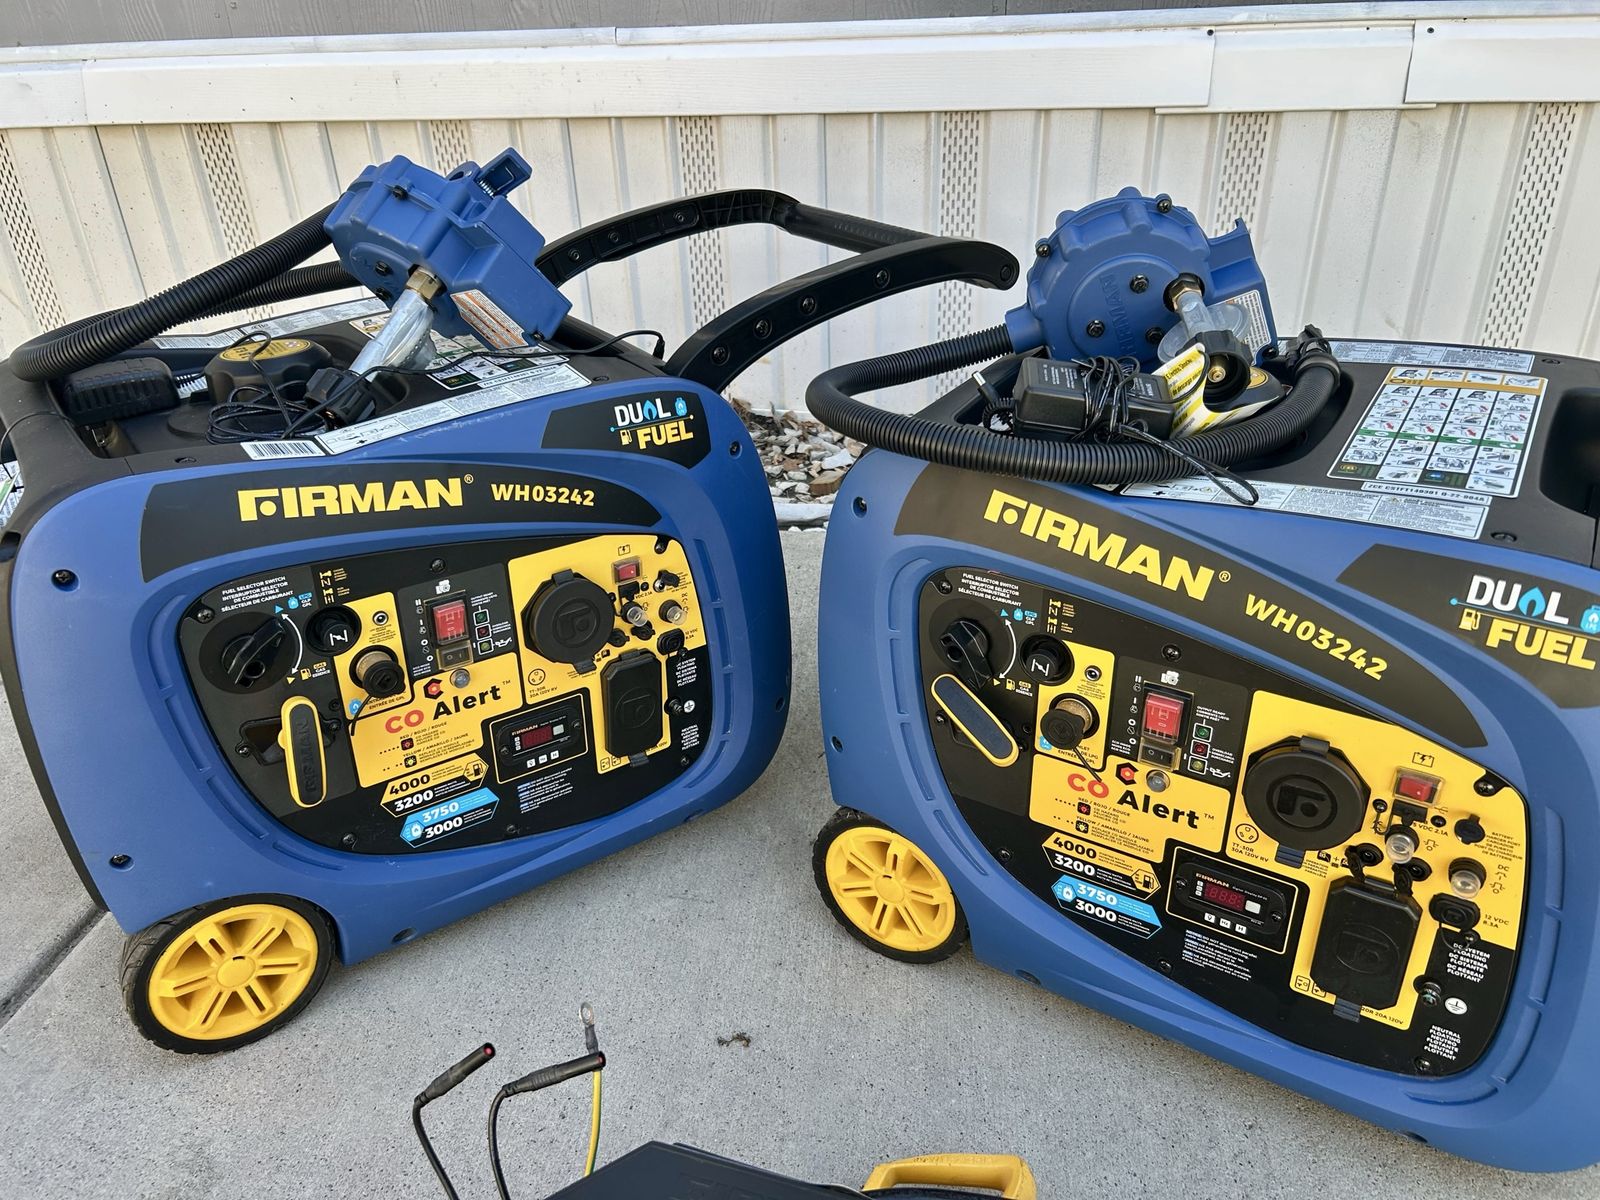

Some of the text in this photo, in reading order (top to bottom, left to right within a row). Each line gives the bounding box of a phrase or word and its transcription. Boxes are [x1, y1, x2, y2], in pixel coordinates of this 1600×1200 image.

[637, 420, 694, 450] FUEL
[491, 483, 595, 507] WH03242
[236, 581, 264, 591] SELECTOR
[264, 576, 286, 585] SWITCH
[961, 578, 1019, 597] INTERRUPTOR SELECTOR
[975, 575, 999, 586] SELECTOR
[999, 581, 1019, 590] SWITCH
[222, 581, 288, 601] INTERRUPTOR SELECTOR
[242, 588, 279, 601] COMBUSTIBLE
[260, 590, 294, 602] CARBURANT
[977, 586, 1011, 599] COMBUSTIBLE
[992, 595, 1022, 607] CARBURANT
[1245, 594, 1388, 681] WH03242
[1485, 618, 1596, 671] FUEL
[385, 709, 425, 734] CO
[433, 685, 502, 720] Alert
[389, 774, 431, 795] 4000
[394, 790, 434, 812] 3200
[1067, 773, 1110, 799] CO
[1116, 789, 1200, 829] Alert
[422, 801, 459, 823] 3750
[425, 816, 463, 839] 3000
[1418, 824, 1434, 832] VDC
[1053, 836, 1097, 859] 4000
[1054, 853, 1096, 876] 3200
[1497, 864, 1510, 872] DC
[1077, 883, 1118, 906] 3750
[1075, 899, 1117, 922] 3000
[1494, 916, 1510, 925] VDC
[1450, 958, 1485, 973] FLOTANTE
[1459, 956, 1489, 970] SISTEMA
[1447, 968, 1481, 984] FLOTTANT
[1429, 1028, 1461, 1044] FLOATING
[1431, 1024, 1461, 1039] NEUTRAL
[1426, 1037, 1459, 1053] FLOTANTE
[1430, 1033, 1457, 1047] NEUTRO
[1424, 1045, 1456, 1061] FLOTTANT
[1429, 1043, 1454, 1055] NEUTRE
